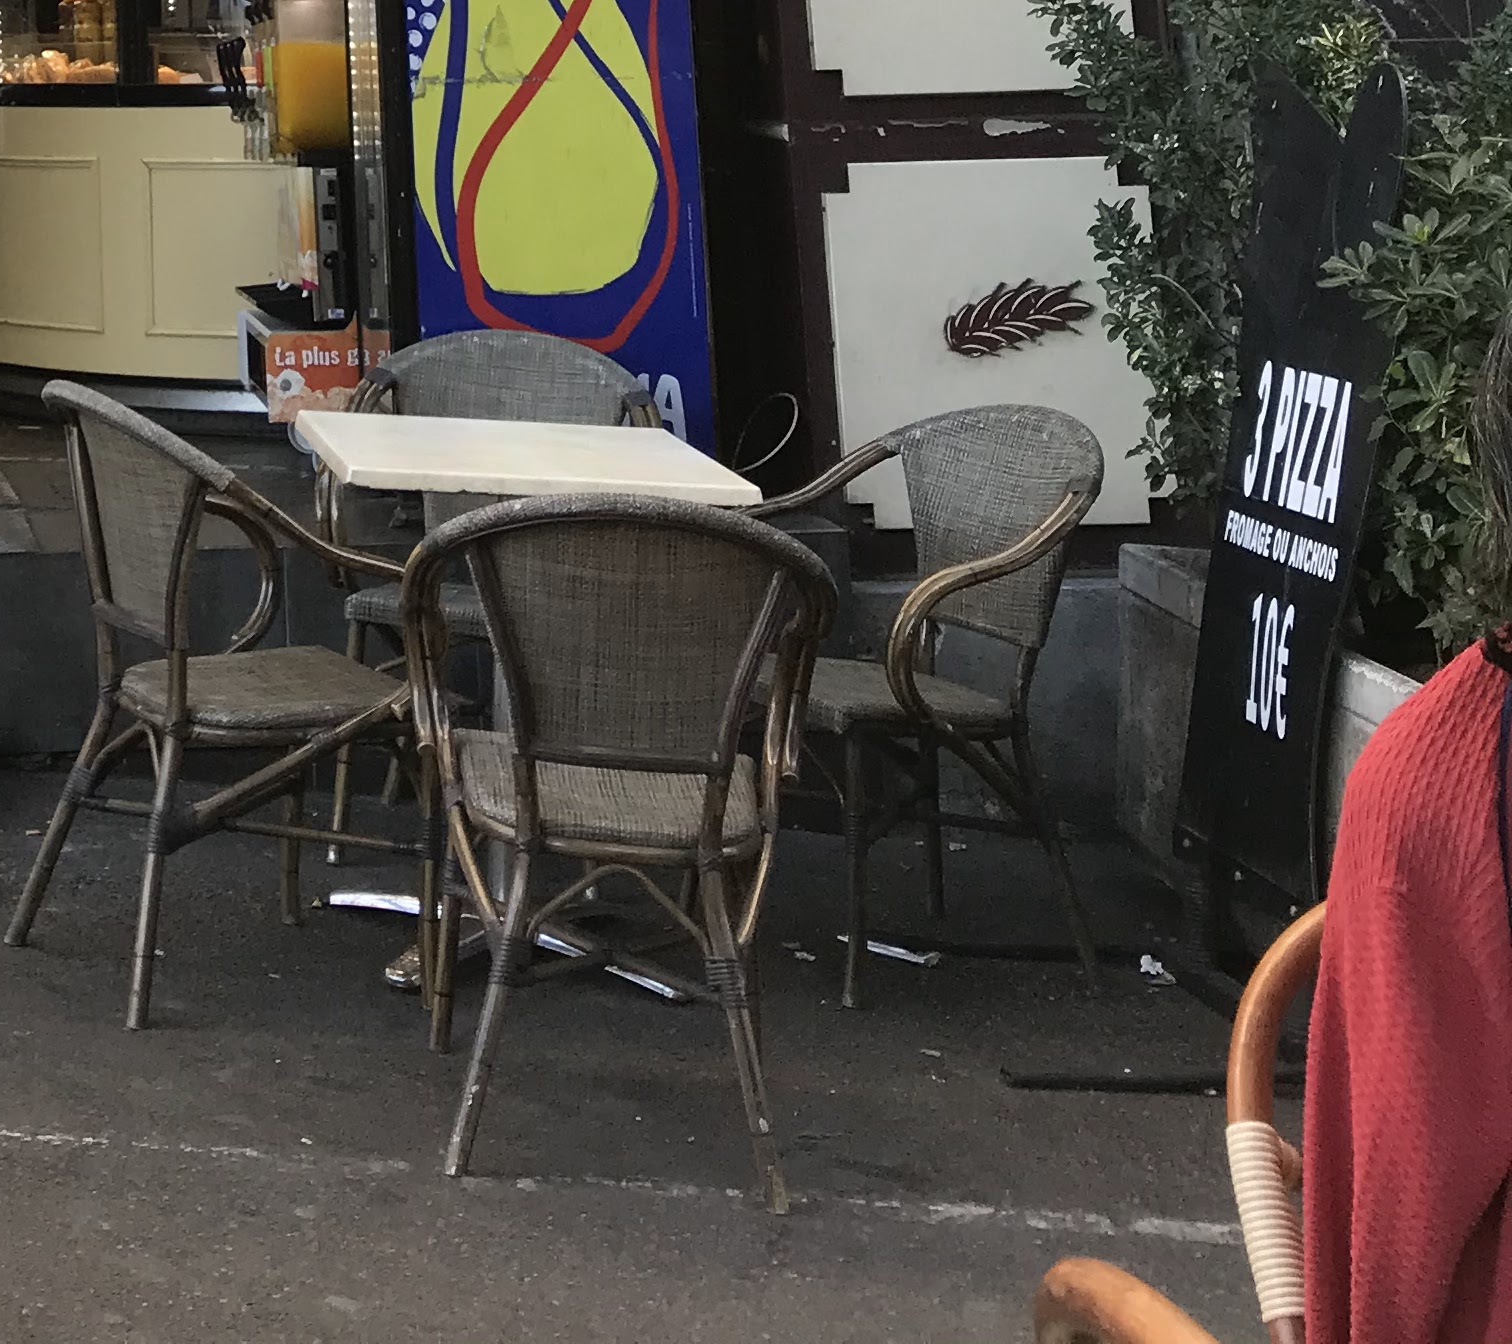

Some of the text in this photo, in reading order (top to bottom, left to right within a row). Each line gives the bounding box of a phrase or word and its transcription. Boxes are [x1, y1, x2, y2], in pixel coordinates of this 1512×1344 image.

[274, 346, 296, 366] La
[301, 345, 340, 368] plus
[1242, 359, 1353, 524] 3 PIZZA
[1224, 509, 1339, 583] FROMAGE OU ANCHOIS
[1245, 592, 1295, 741] 10€
